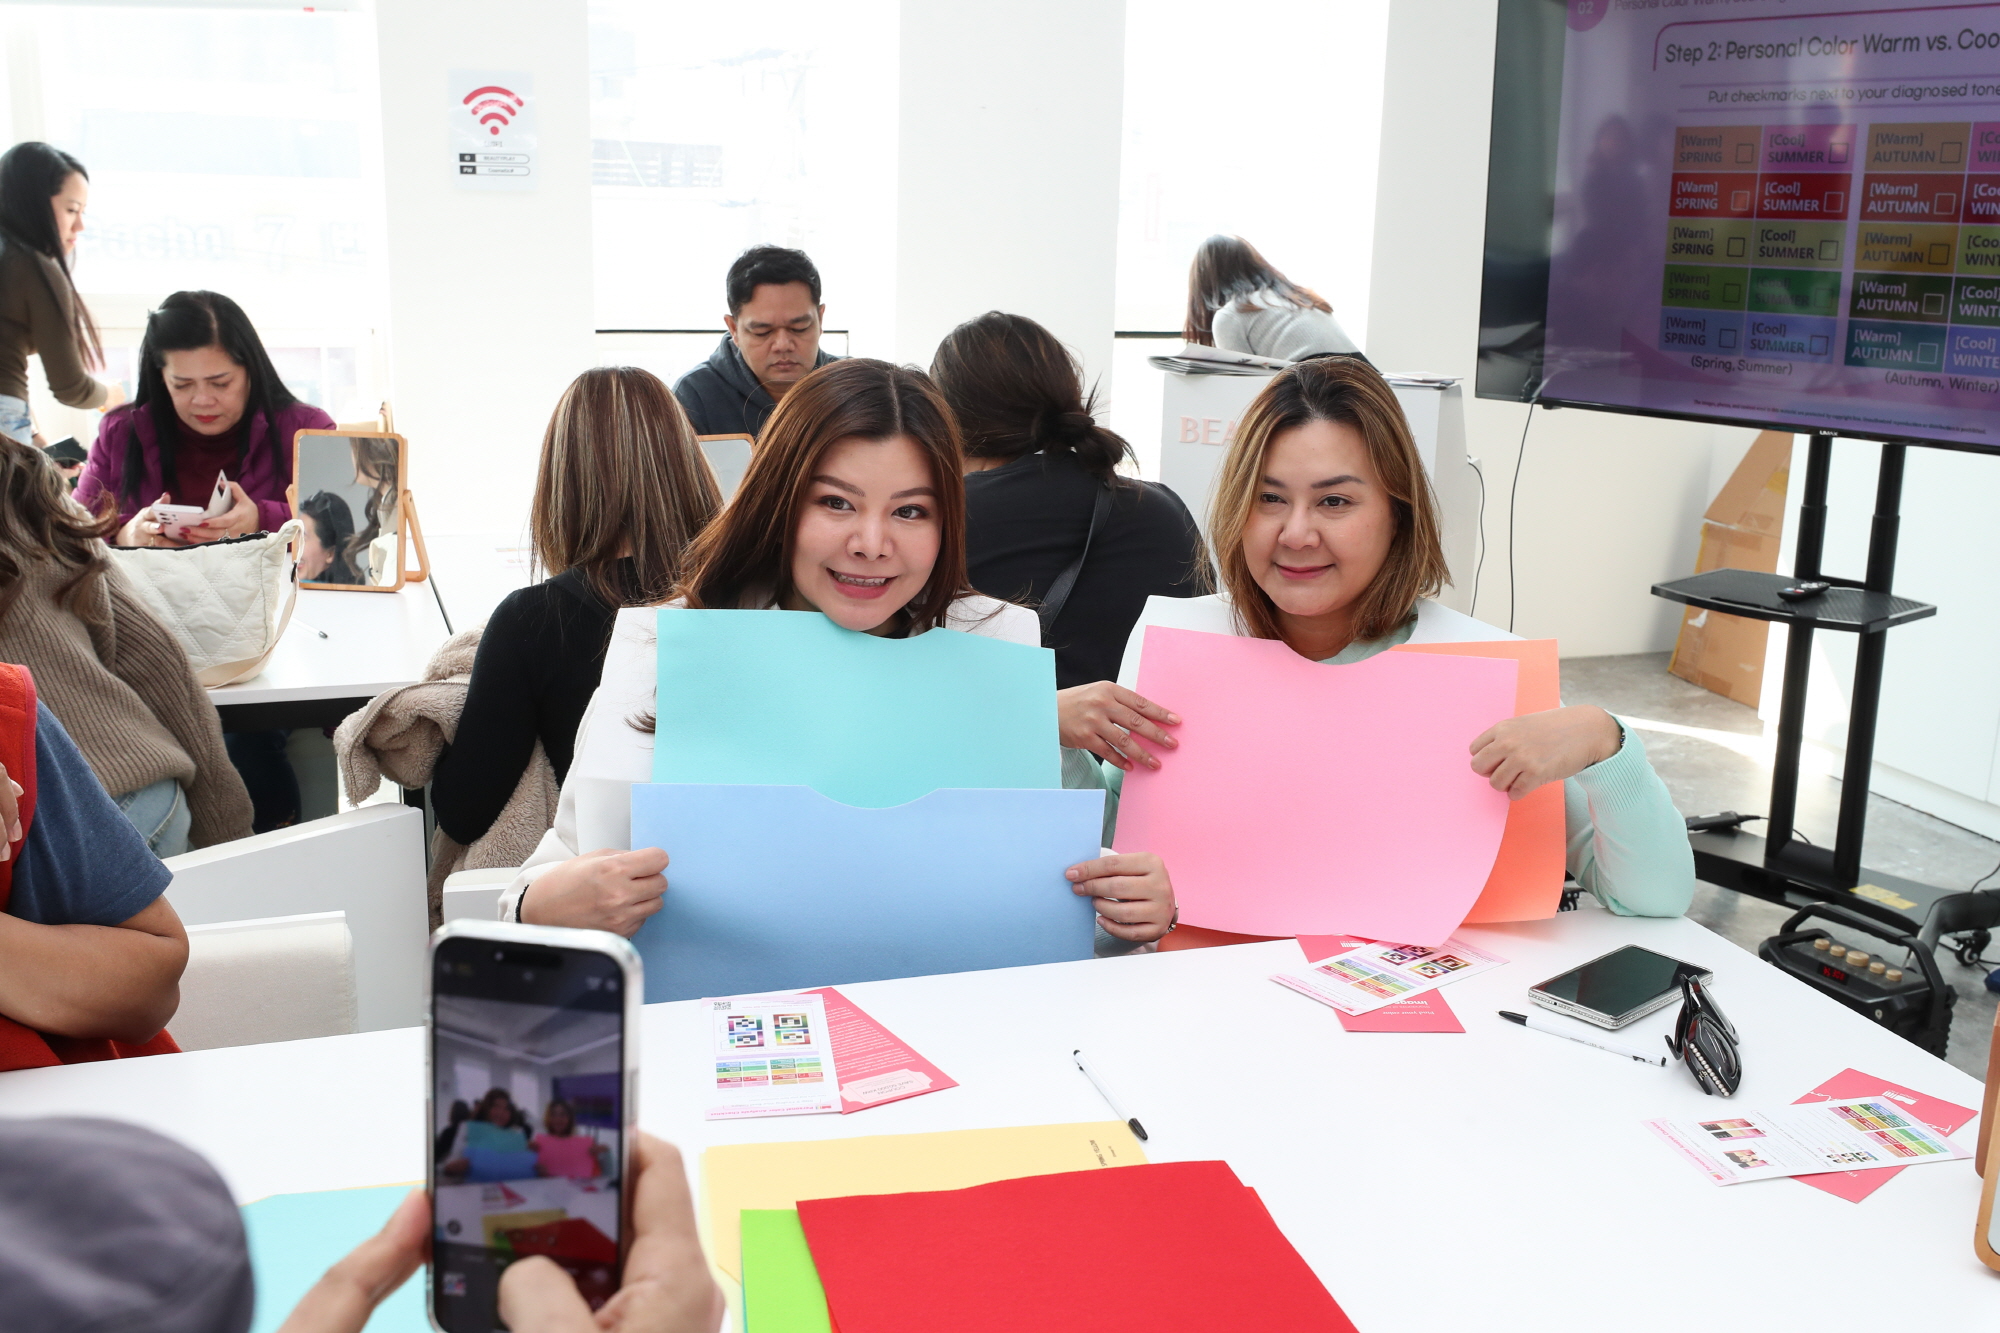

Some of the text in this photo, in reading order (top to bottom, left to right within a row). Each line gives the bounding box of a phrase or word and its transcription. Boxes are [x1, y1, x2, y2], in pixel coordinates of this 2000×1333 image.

[1577, 2, 1594, 15] 02
[1665, 43, 1703, 66] Step
[1707, 41, 1722, 61] 2:
[1725, 36, 1803, 60] Personal
[1807, 35, 1858, 57] Color
[1863, 33, 1920, 54] Warm
[1926, 35, 1952, 52] vs.
[1708, 90, 1728, 103] Put
[1731, 88, 1807, 103] checkmarks
[1810, 88, 1839, 100] next
[1841, 87, 1854, 100] to
[1857, 87, 1890, 102] your
[1891, 83, 1968, 101] diagnosed
[1681, 135, 1722, 148] [Warm]
[1769, 134, 1806, 148] [Cool]
[1876, 132, 1924, 147] [Warm]
[1679, 151, 1722, 163] SPRING
[1768, 151, 1824, 163] SUMMER
[1873, 150, 1936, 163] AUTUMN
[1677, 181, 1718, 195] [Warm]
[1765, 182, 1801, 196] [Cool]
[1869, 182, 1918, 198] [Warm]
[1675, 197, 1718, 210] SPRING
[1763, 199, 1819, 212] SUMMER
[1867, 200, 1930, 214] AUTUMN
[1673, 226, 1714, 241] [Warm]
[1760, 229, 1796, 243] [Cool]
[1864, 232, 1912, 248] [Warm]
[1672, 243, 1714, 256] SPRING
[1758, 246, 1815, 260] SUMMER
[1862, 250, 1924, 263] AUTUMN
[1669, 271, 1710, 286] [Warm]
[1668, 287, 1710, 300] SPRING
[1860, 280, 1907, 297] [Warm]
[1857, 298, 1919, 313] AUTUMN
[1666, 316, 1706, 331] [Warm]
[1752, 322, 1787, 337] [Cool]
[1664, 332, 1706, 346] SPRING
[1854, 329, 1902, 346] [Warm]
[1955, 335, 1997, 353] [Cool]
[1750, 338, 1805, 354] SUMMER
[1851, 346, 1913, 362] AUTUMN
[1691, 355, 1793, 376] (Spring, Summer)
[1885, 371, 2000, 394] (Autumn, Winter)
